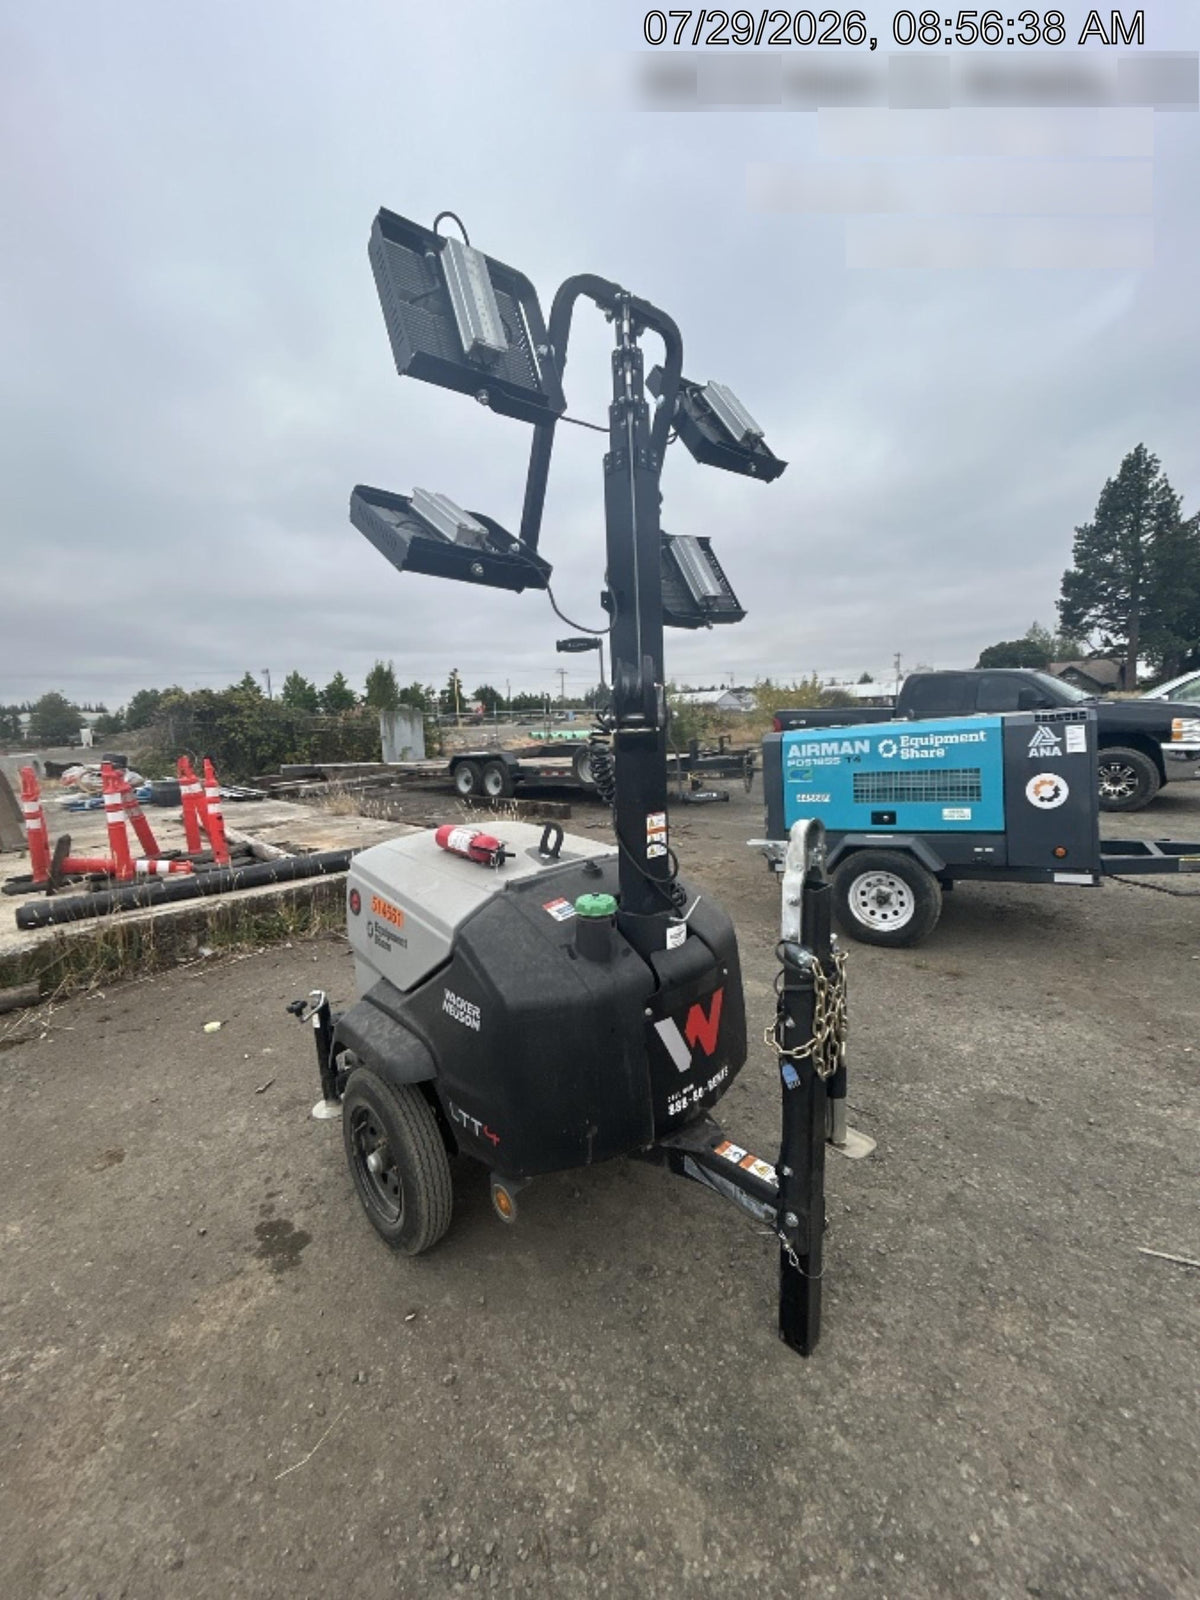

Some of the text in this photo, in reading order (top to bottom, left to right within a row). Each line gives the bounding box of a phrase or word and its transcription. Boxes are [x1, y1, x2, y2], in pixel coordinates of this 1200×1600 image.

[900, 730, 987, 748] Equipment
[788, 740, 870, 757] AIRMAN
[900, 748, 945, 760] Share
[1027, 746, 1063, 758] ANA
